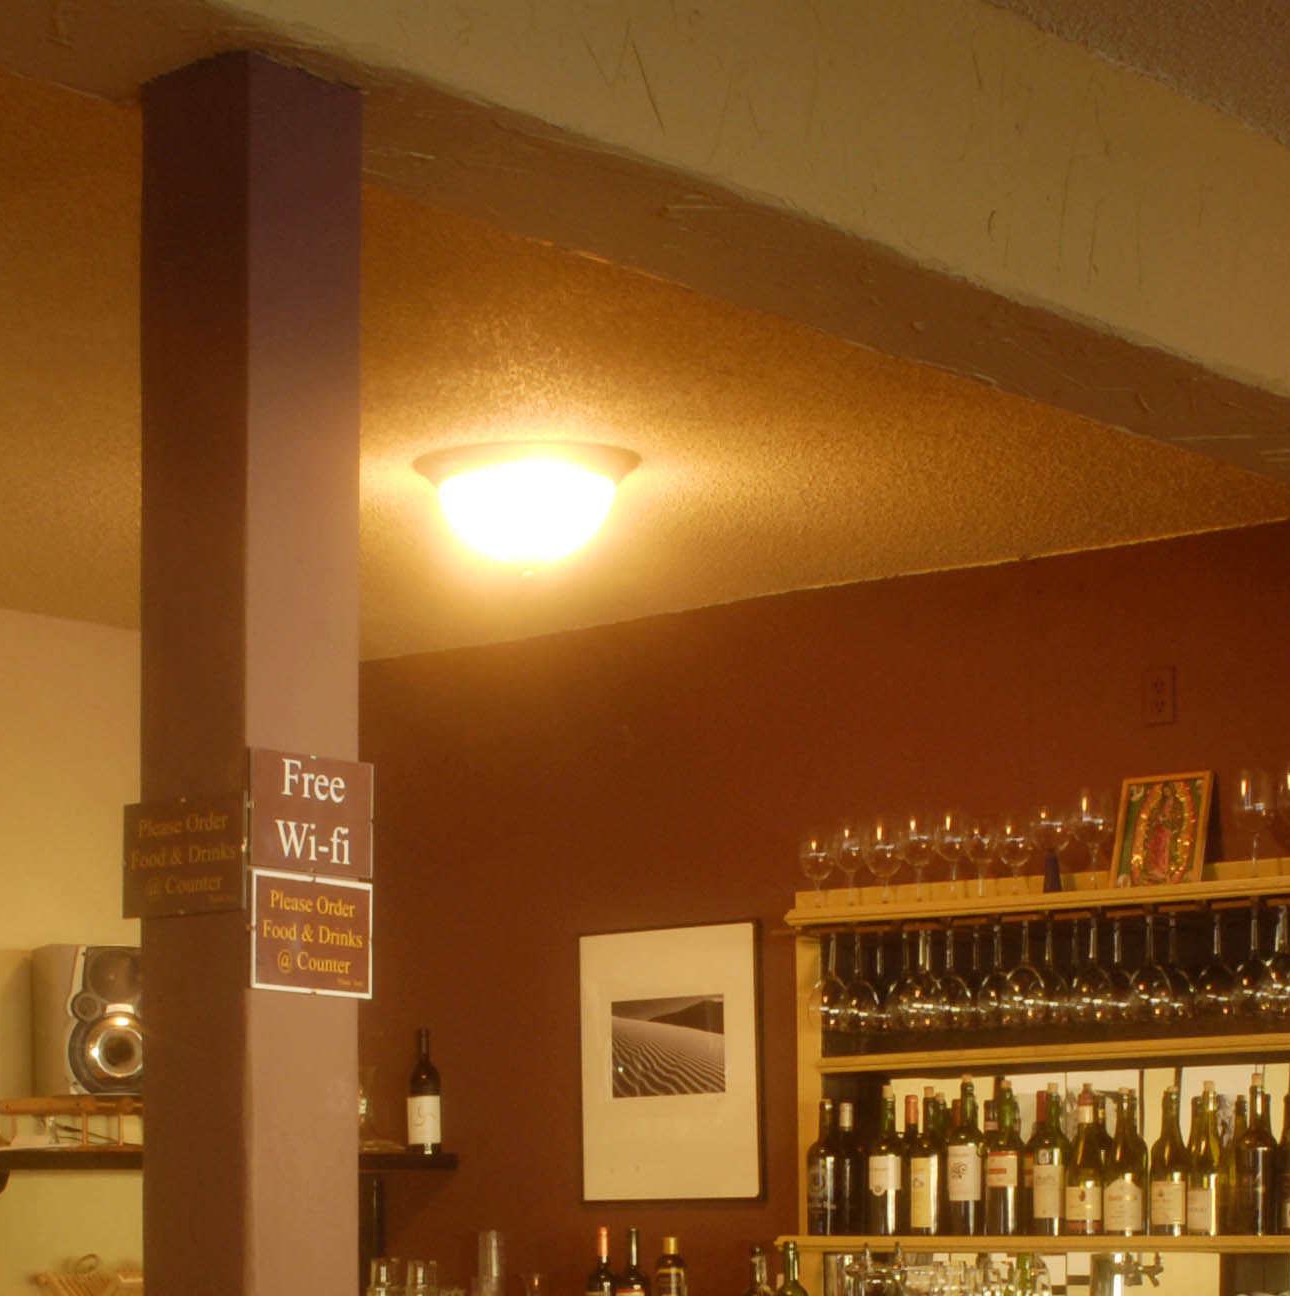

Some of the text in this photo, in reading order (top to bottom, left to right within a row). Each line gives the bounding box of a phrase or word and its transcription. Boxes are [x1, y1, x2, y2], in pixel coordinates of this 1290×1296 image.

[281, 758, 345, 803] Free
[138, 812, 228, 838] Please Order
[275, 819, 350, 865] Wi-fi
[131, 842, 237, 871] Food & Drinks
[165, 876, 222, 895] Counter
[270, 890, 356, 918] Please Order
[263, 920, 364, 949] Food & Drinks
[277, 950, 351, 975] @ Counter
